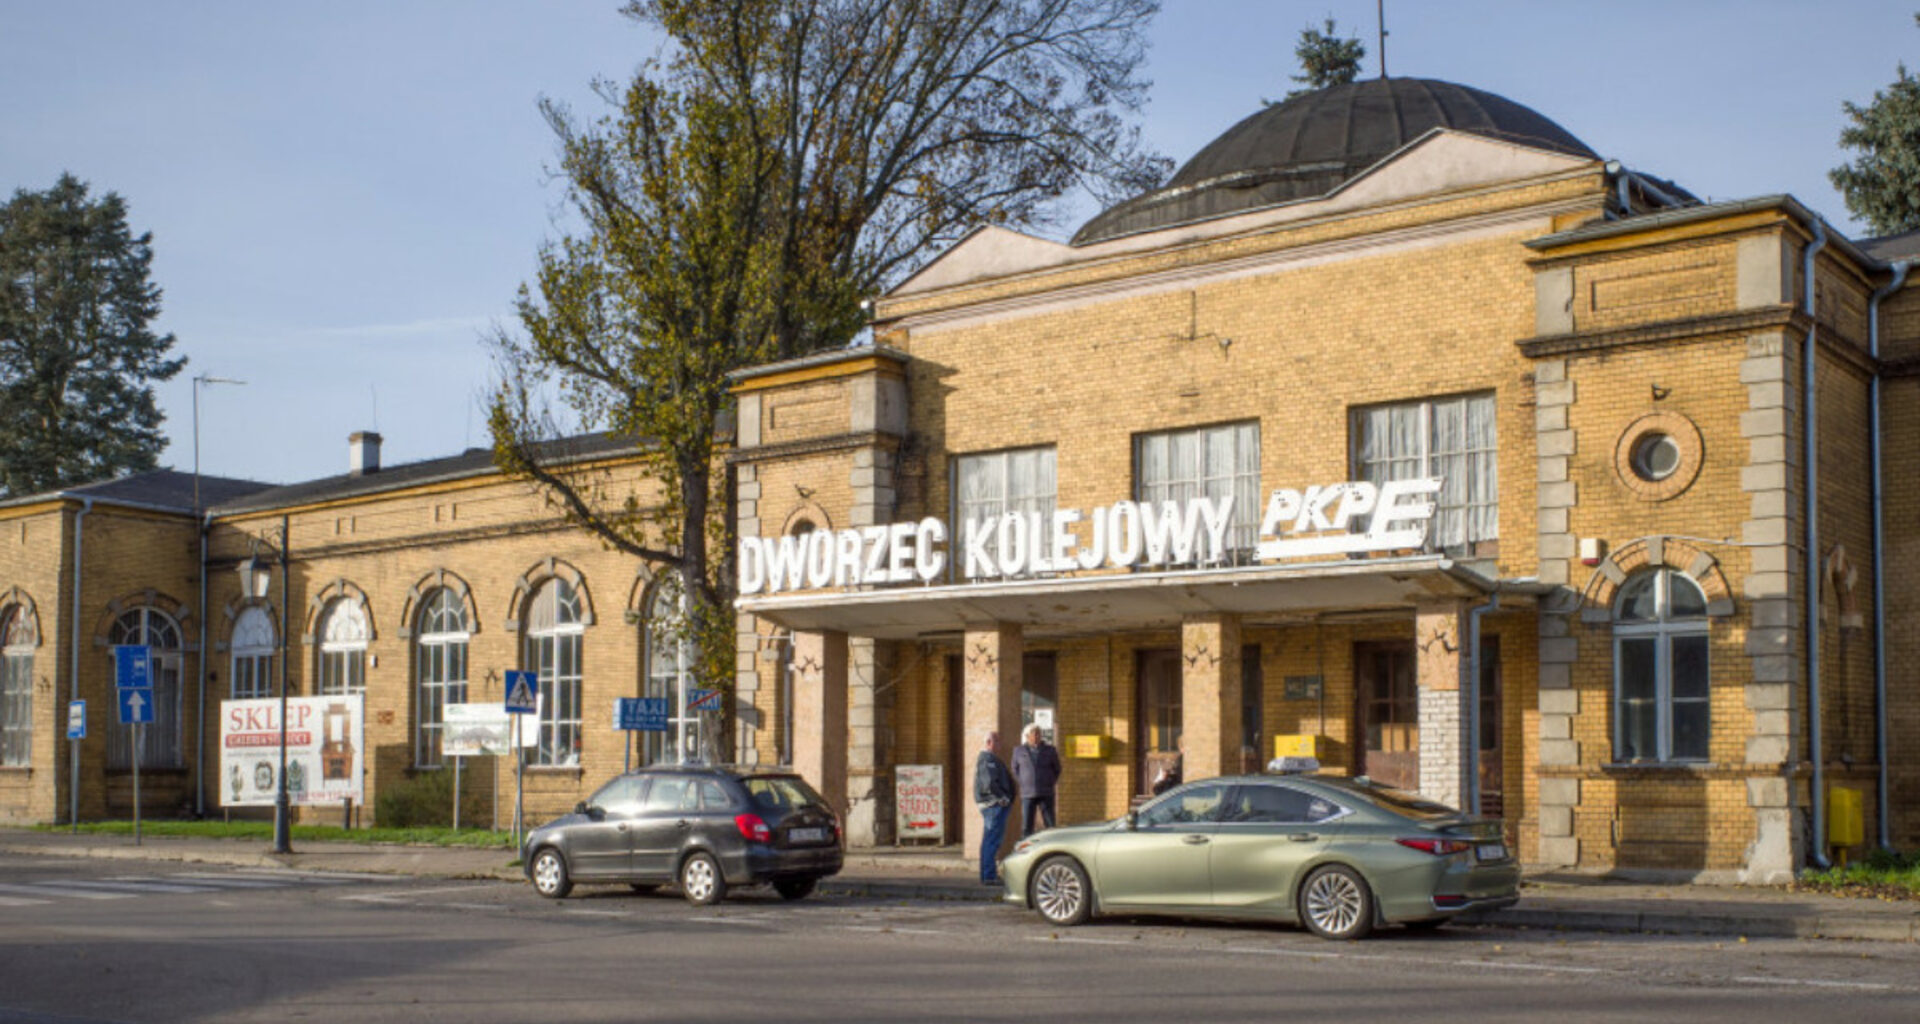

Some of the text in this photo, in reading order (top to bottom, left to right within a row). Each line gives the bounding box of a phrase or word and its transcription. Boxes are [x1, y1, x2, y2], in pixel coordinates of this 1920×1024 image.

[739, 497, 1233, 594] DWORZEC KOLEJOWY
[626, 698, 665, 715] TAXI
[687, 689, 720, 709] TAXI
[230, 704, 312, 732] SKLEP
